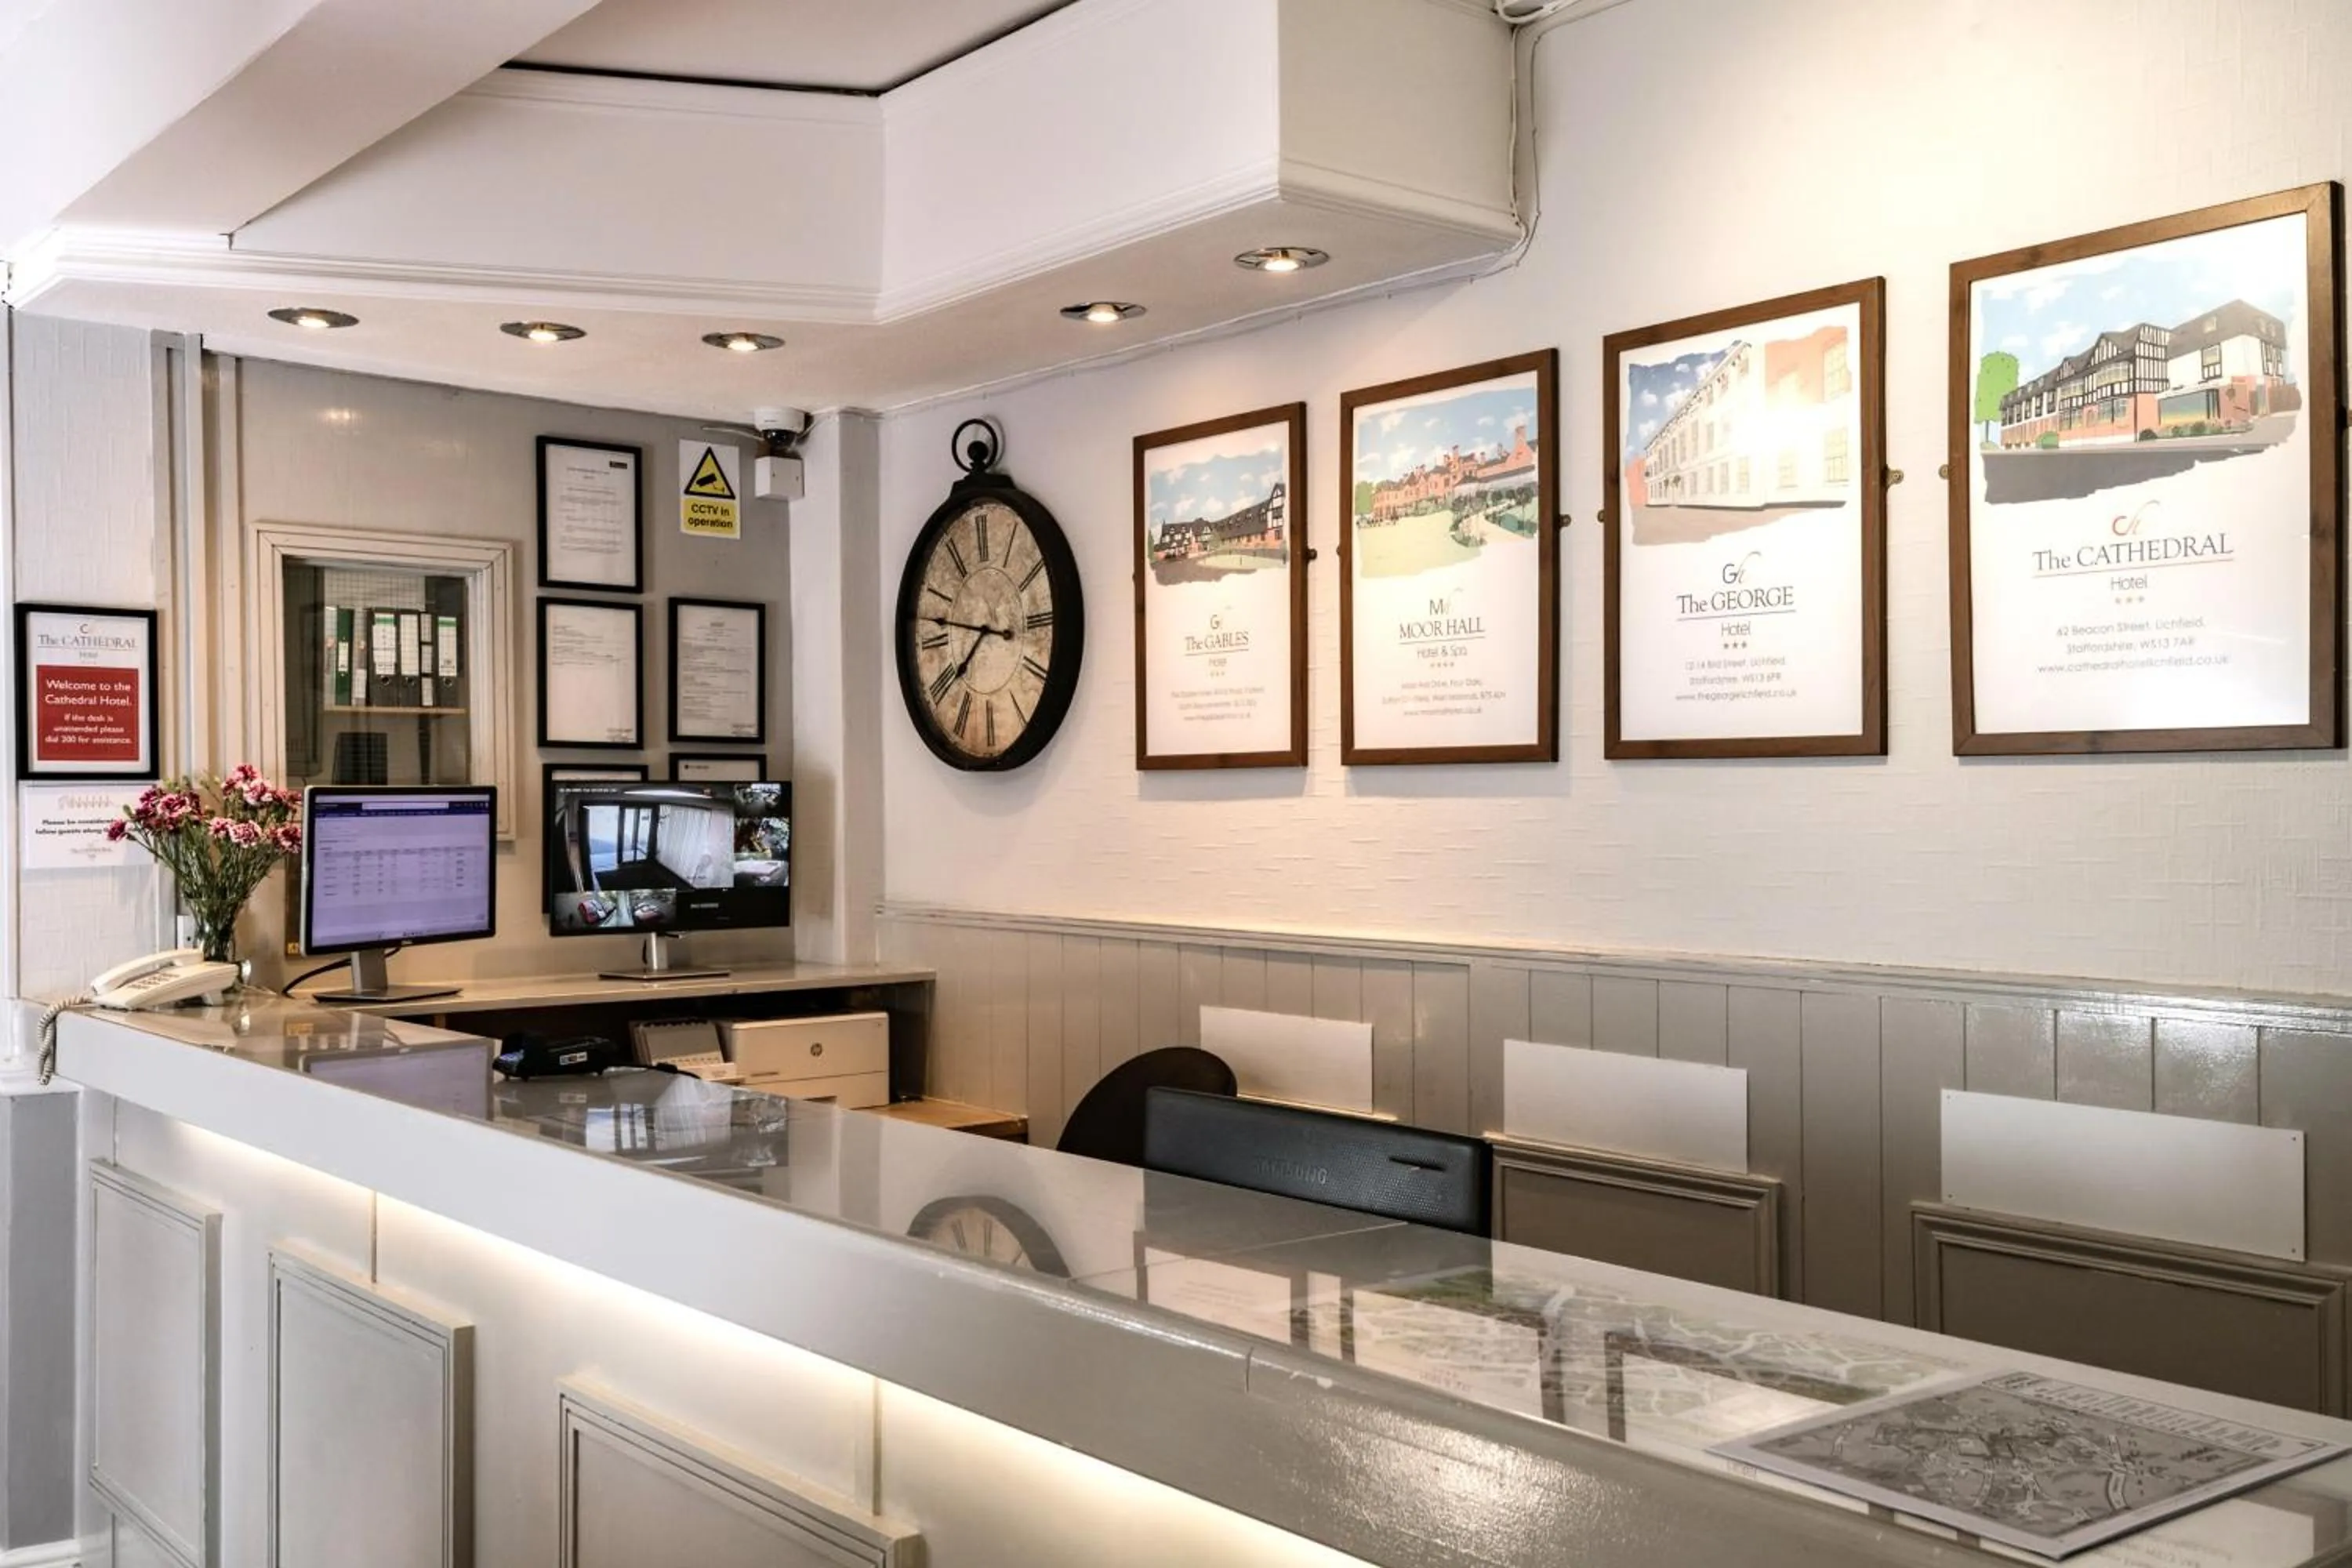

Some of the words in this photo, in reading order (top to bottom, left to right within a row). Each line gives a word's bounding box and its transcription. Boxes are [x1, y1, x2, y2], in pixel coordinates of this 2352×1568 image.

[691, 504, 719, 515] CCTV
[688, 517, 733, 528] operation
[2032, 550, 2071, 572] The
[2077, 533, 2234, 567] CATHEDRAL
[2111, 575, 2148, 591] Hotel
[1676, 593, 1708, 614] The
[1711, 586, 1795, 612] GEORGE
[1399, 619, 1443, 639] MOOR
[1446, 617, 1486, 635] HALL
[1721, 621, 1751, 637] Hotel
[2072, 624, 2114, 636] Beacon
[38, 634, 59, 645] The
[61, 635, 136, 648] CATHEDRAL
[1185, 635, 1203, 651] The
[1204, 630, 1249, 649] GABLES
[1417, 646, 1439, 659] Hotel
[1441, 645, 1448, 657] &
[1450, 644, 1468, 658] Spa
[46, 680, 96, 691] Welcome
[100, 681, 111, 691] to
[114, 682, 131, 691] the
[45, 694, 97, 706] Cathedral
[100, 695, 132, 706] Hotel.
